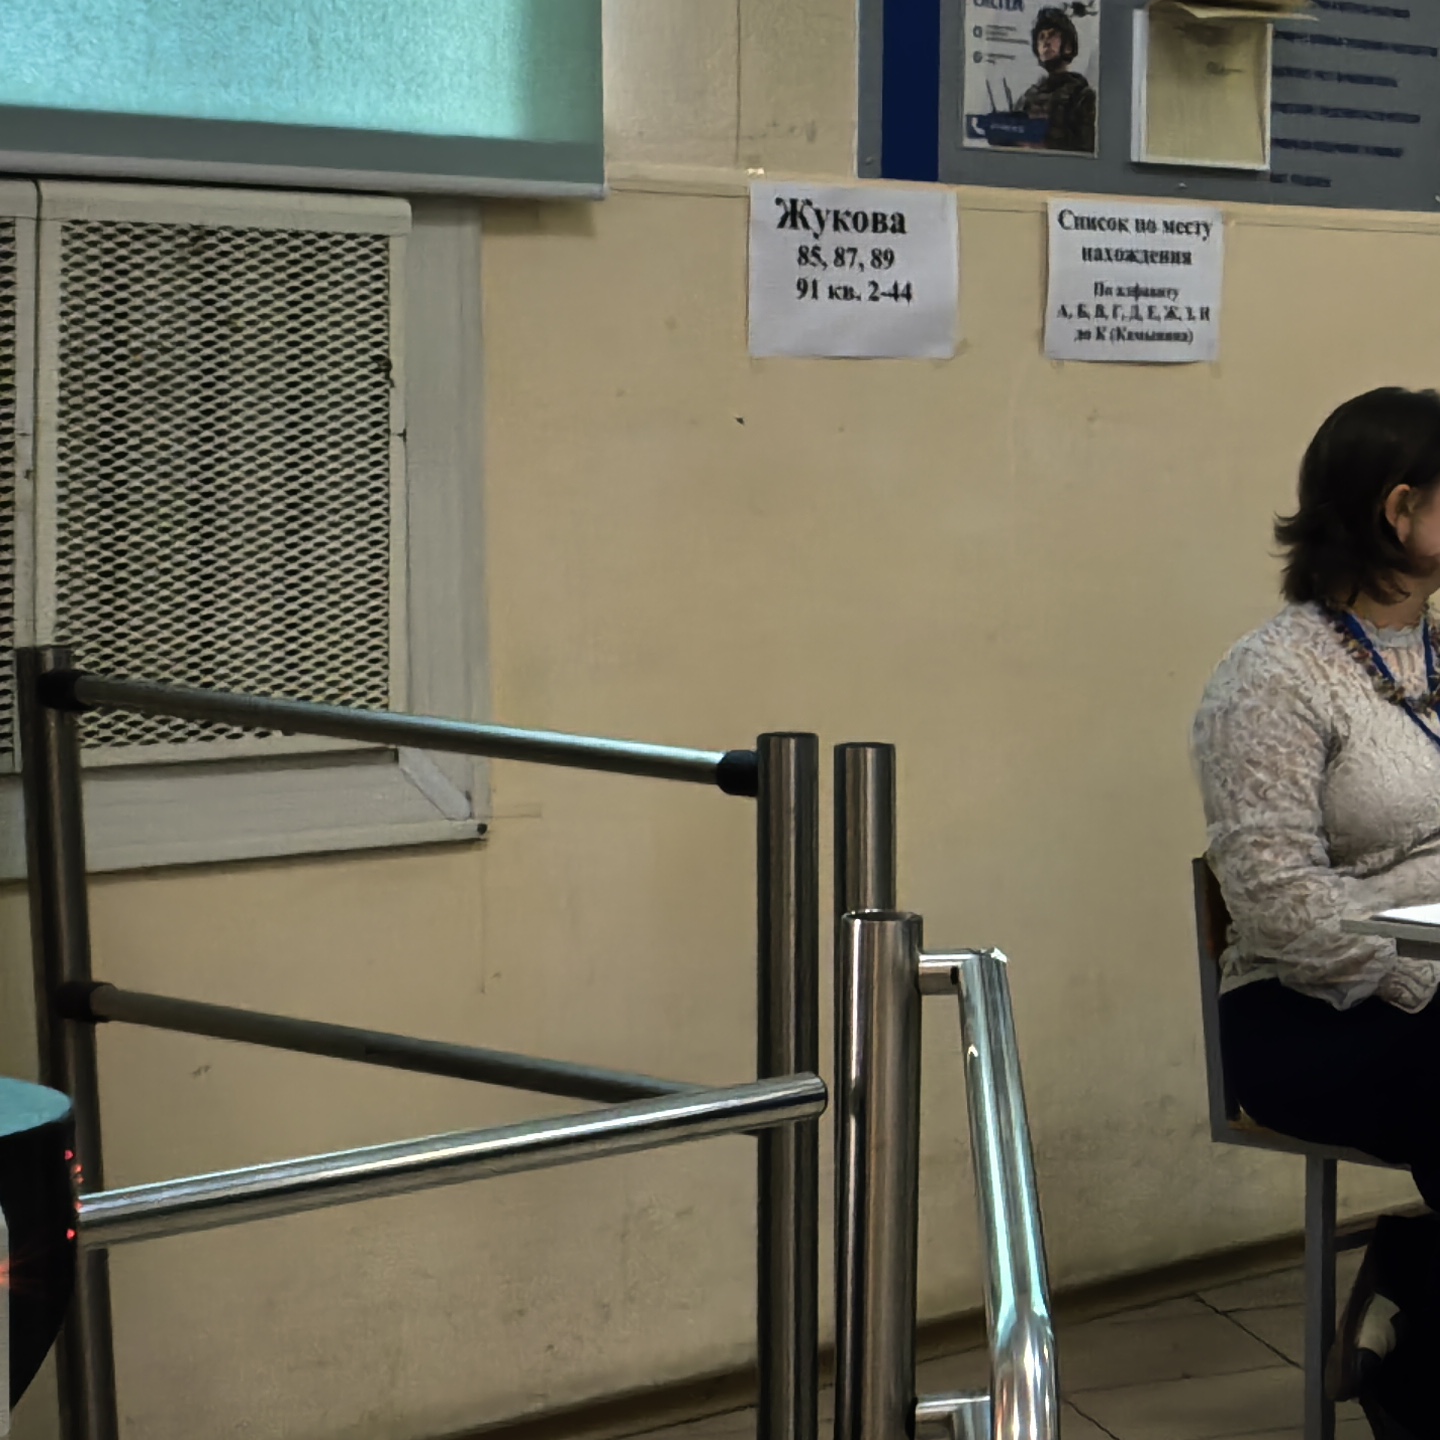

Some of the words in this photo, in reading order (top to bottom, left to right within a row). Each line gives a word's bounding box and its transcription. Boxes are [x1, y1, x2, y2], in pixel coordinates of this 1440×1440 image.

[775, 196, 908, 241] Жукова
[1057, 208, 1130, 233] Список
[1135, 218, 1157, 234] по
[1162, 219, 1213, 241] месту
[797, 244, 829, 271] 85,
[833, 246, 865, 272] 87,
[870, 247, 895, 270] 89
[1082, 246, 1193, 266] нахождения
[796, 277, 818, 300] 91
[828, 284, 862, 301] кв.
[867, 280, 913, 304] 2-44
